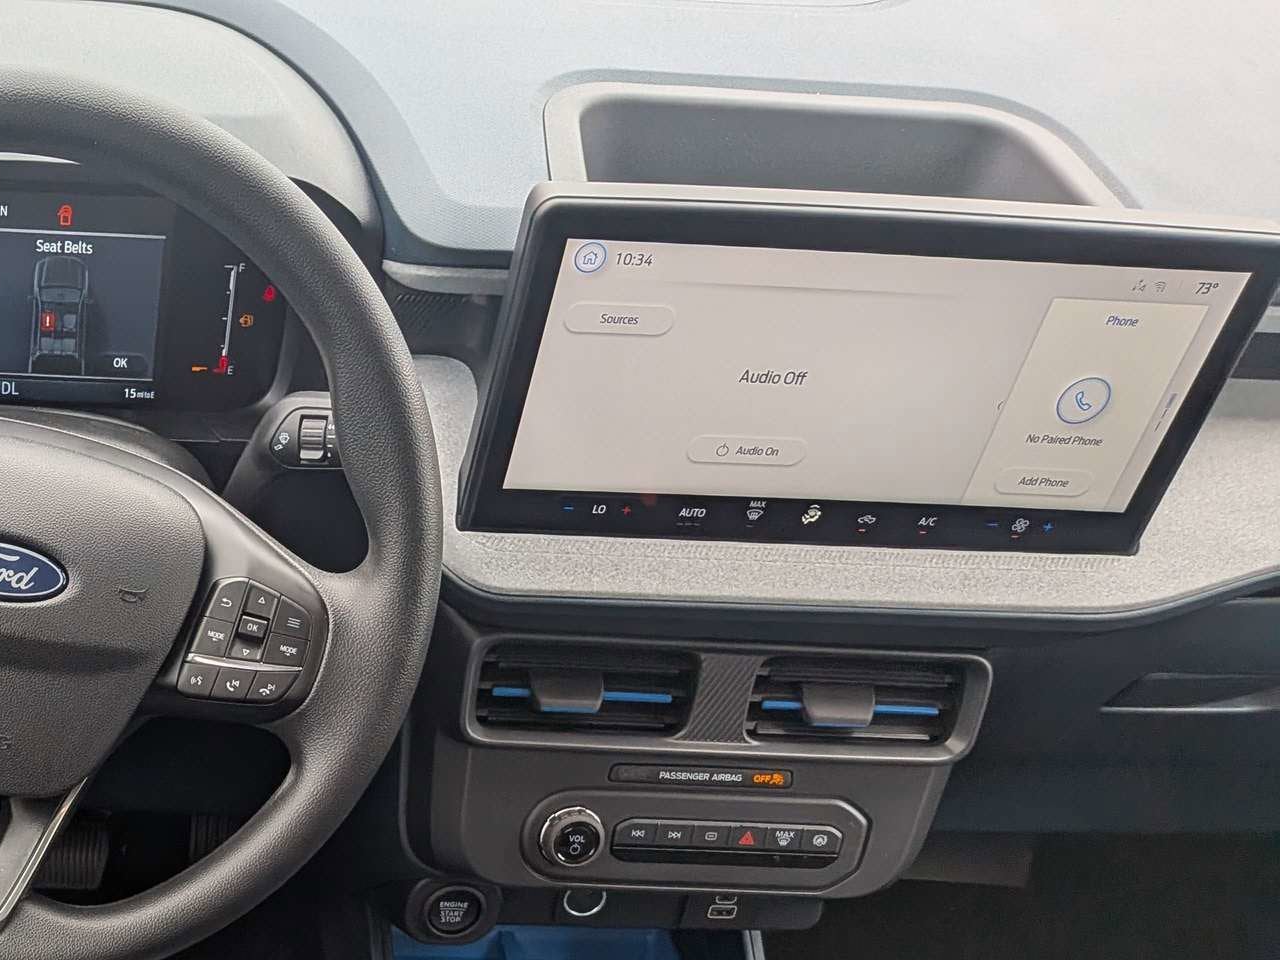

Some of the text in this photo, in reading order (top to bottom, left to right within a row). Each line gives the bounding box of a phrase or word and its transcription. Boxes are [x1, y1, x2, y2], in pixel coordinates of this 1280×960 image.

[0, 205, 8, 217] N
[36, 240, 93, 254] Seat Belts
[616, 252, 653, 266] 10:34
[238, 263, 246, 273] F
[600, 313, 639, 325] Sources
[1106, 315, 1138, 327] Phone
[113, 357, 128, 368] OK
[227, 365, 234, 375] E
[739, 369, 808, 385] Audio Off
[124, 388, 136, 399] 15
[1026, 434, 1103, 446] No Paired Phone
[735, 446, 780, 456] Audio On
[1018, 476, 1070, 487] Add Phone
[592, 504, 607, 515] LO
[749, 500, 767, 508] MAX
[678, 508, 706, 518] AUTO
[918, 517, 938, 527] A/C
[246, 623, 259, 632] OK
[207, 630, 224, 640] MODE
[280, 644, 298, 655] MODE
[659, 771, 770, 784] PASSENGER AIRBAG OFF
[569, 834, 585, 843] VOL
[775, 830, 795, 839] MAX
[439, 901, 469, 909] ENGINE
